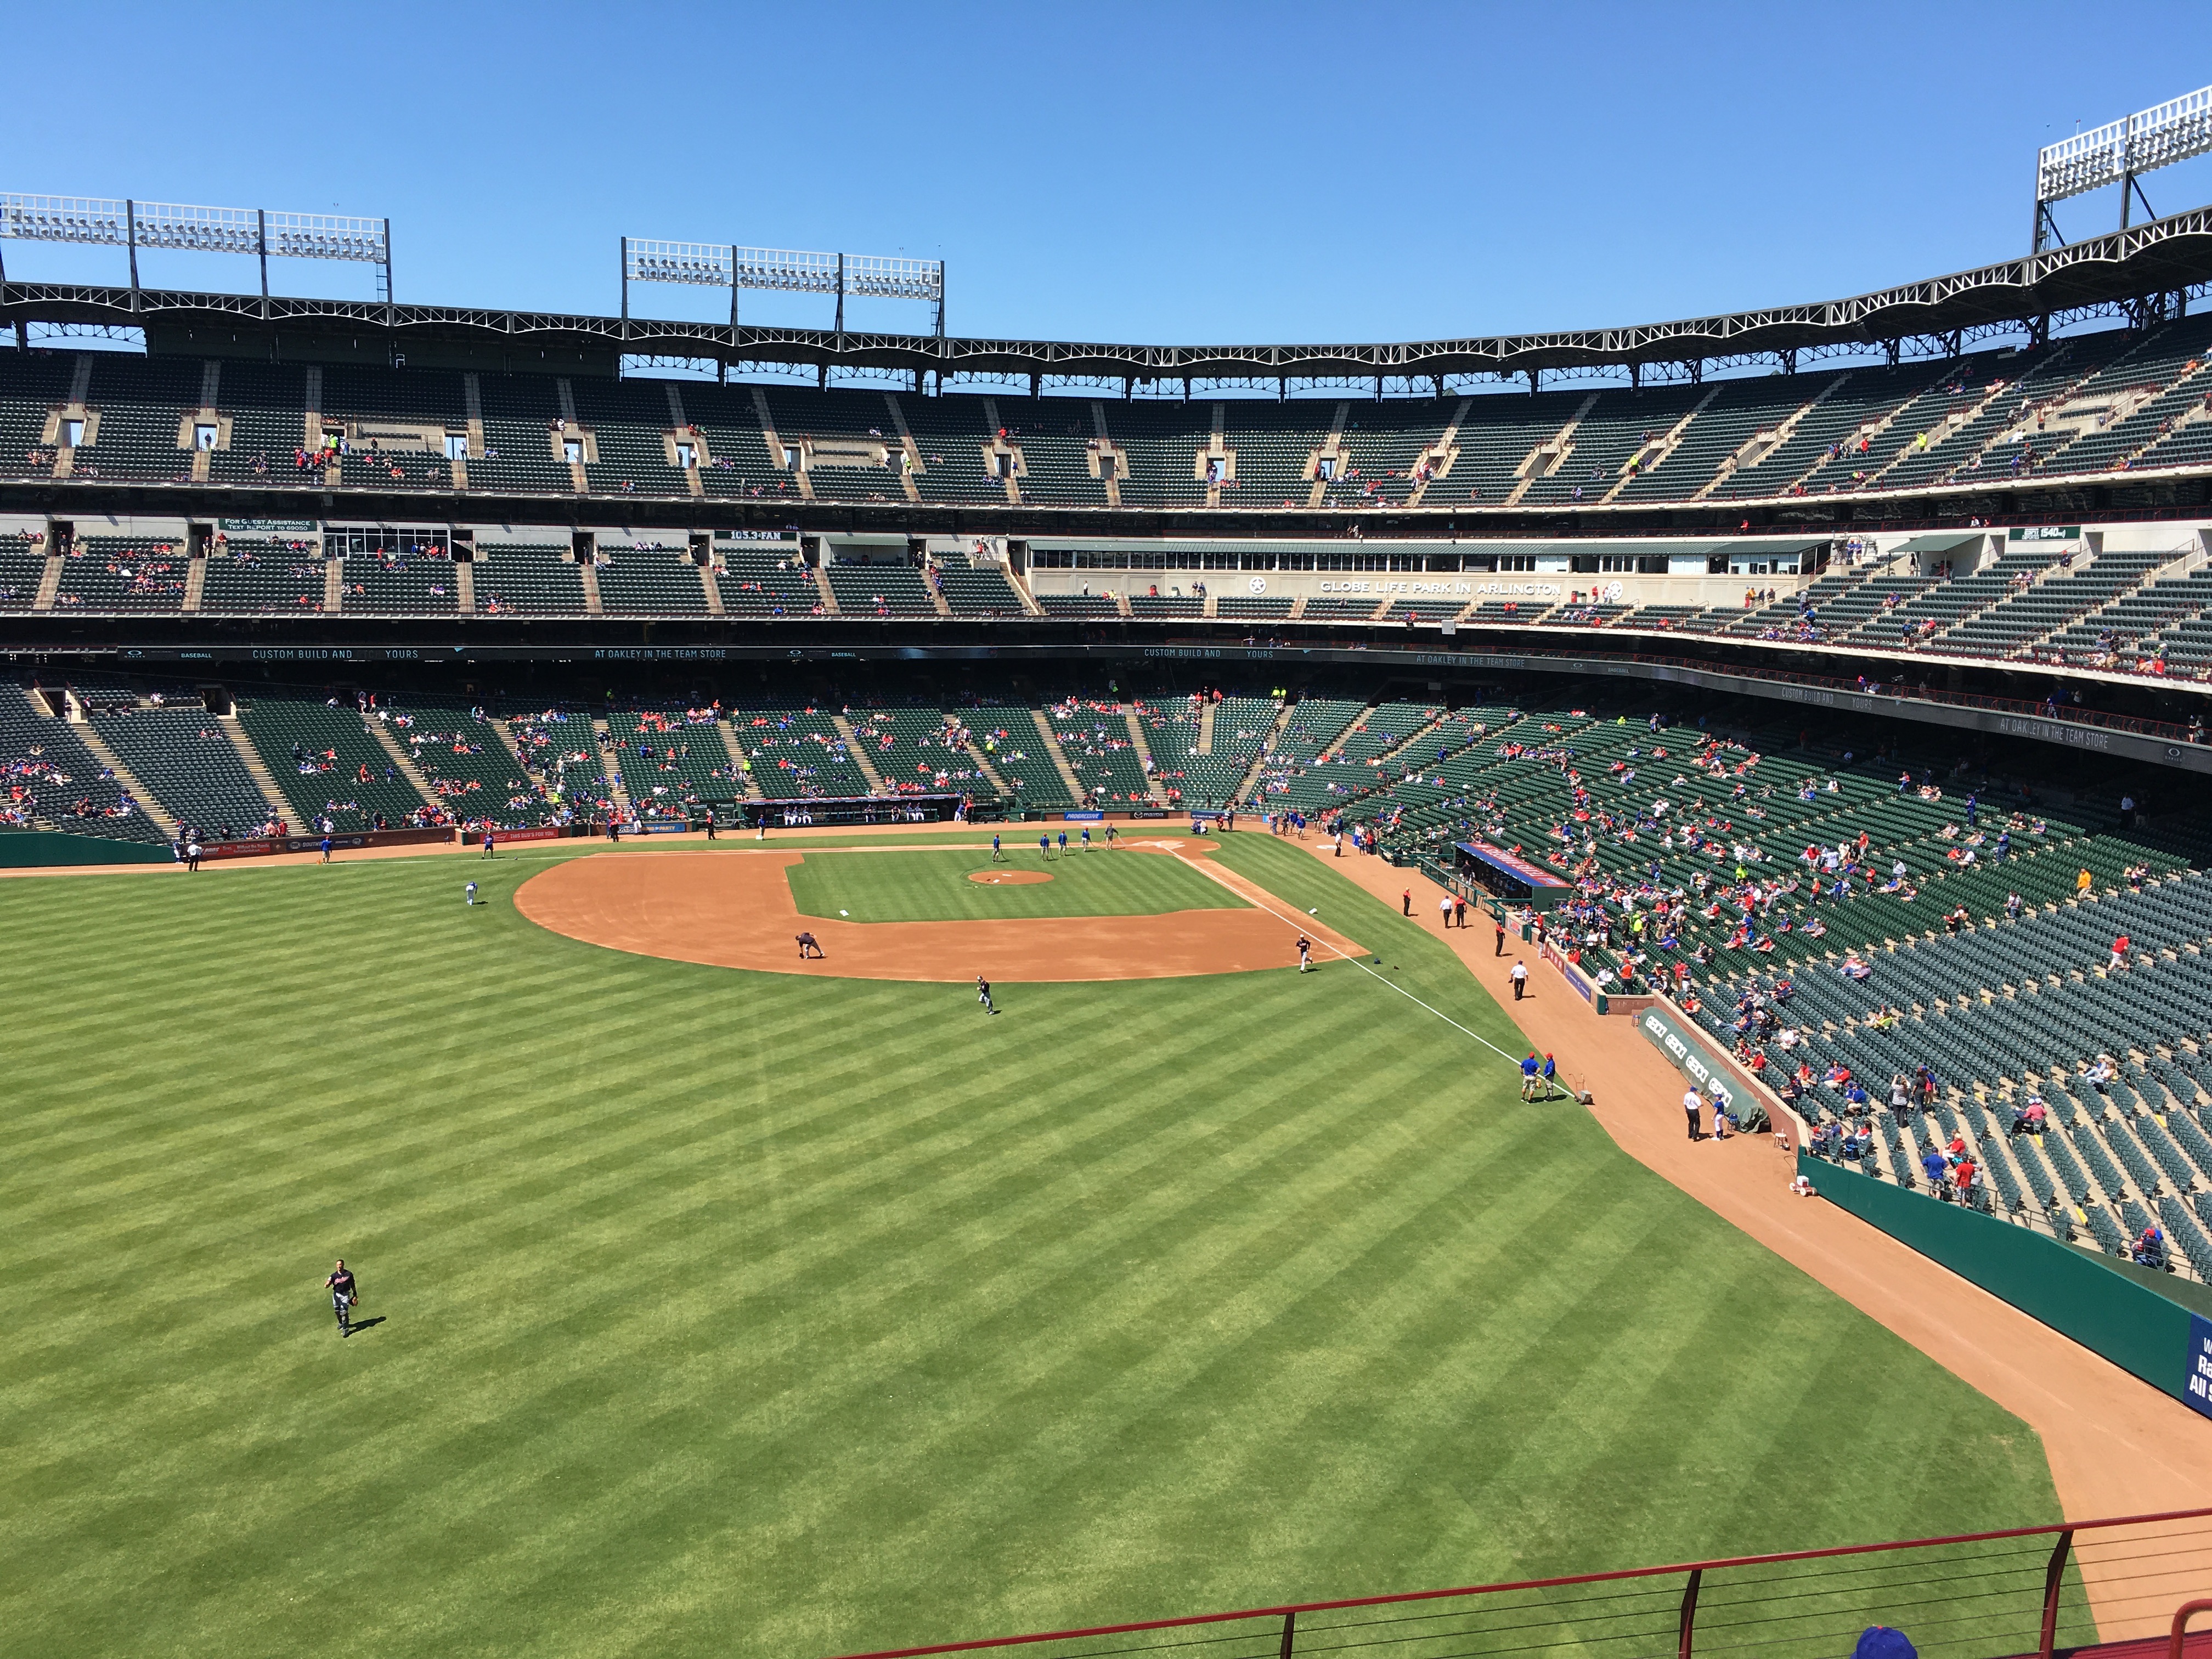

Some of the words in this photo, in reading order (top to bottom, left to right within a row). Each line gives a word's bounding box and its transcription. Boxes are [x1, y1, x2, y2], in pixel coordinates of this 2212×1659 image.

[731, 531, 758, 539] 105.3
[1321, 582, 1370, 592] GLOBE
[1376, 582, 1407, 592] LIFE
[1413, 583, 1451, 593] PARK
[1456, 583, 1471, 594] IN
[1477, 583, 1561, 595] ARLINGTON
[252, 650, 294, 658] CUSTOM
[298, 650, 328, 658] BUILD
[332, 650, 352, 658] AND
[385, 650, 419, 658] YOURS
[595, 650, 605, 658] AT
[608, 650, 641, 658] OAKLEY
[700, 650, 726, 658] STORE
[1144, 648, 1176, 657] CUSTOM
[1246, 650, 1273, 658] YOURS
[1427, 656, 1456, 664] OAKLEY
[1487, 658, 1503, 666] TEAM
[1505, 659, 1525, 667] STORE
[1782, 687, 1803, 699] CUSTOM
[1804, 690, 1820, 702] BUILD
[1822, 693, 1834, 704] AND
[1852, 697, 1872, 710] YOURS
[2000, 718, 2010, 731] AT
[2012, 719, 2041, 736] OAKLEY
[2042, 724, 2050, 737] IN
[2051, 726, 2063, 740] THE
[2066, 728, 2084, 743] TEAM
[2086, 732, 2109, 749] STORE
[1646, 1015, 1668, 1038] GEICO
[1664, 1034, 1688, 1060] GEICO
[1685, 1055, 1709, 1083] GEICO
[2189, 1374, 2207, 1398] All
